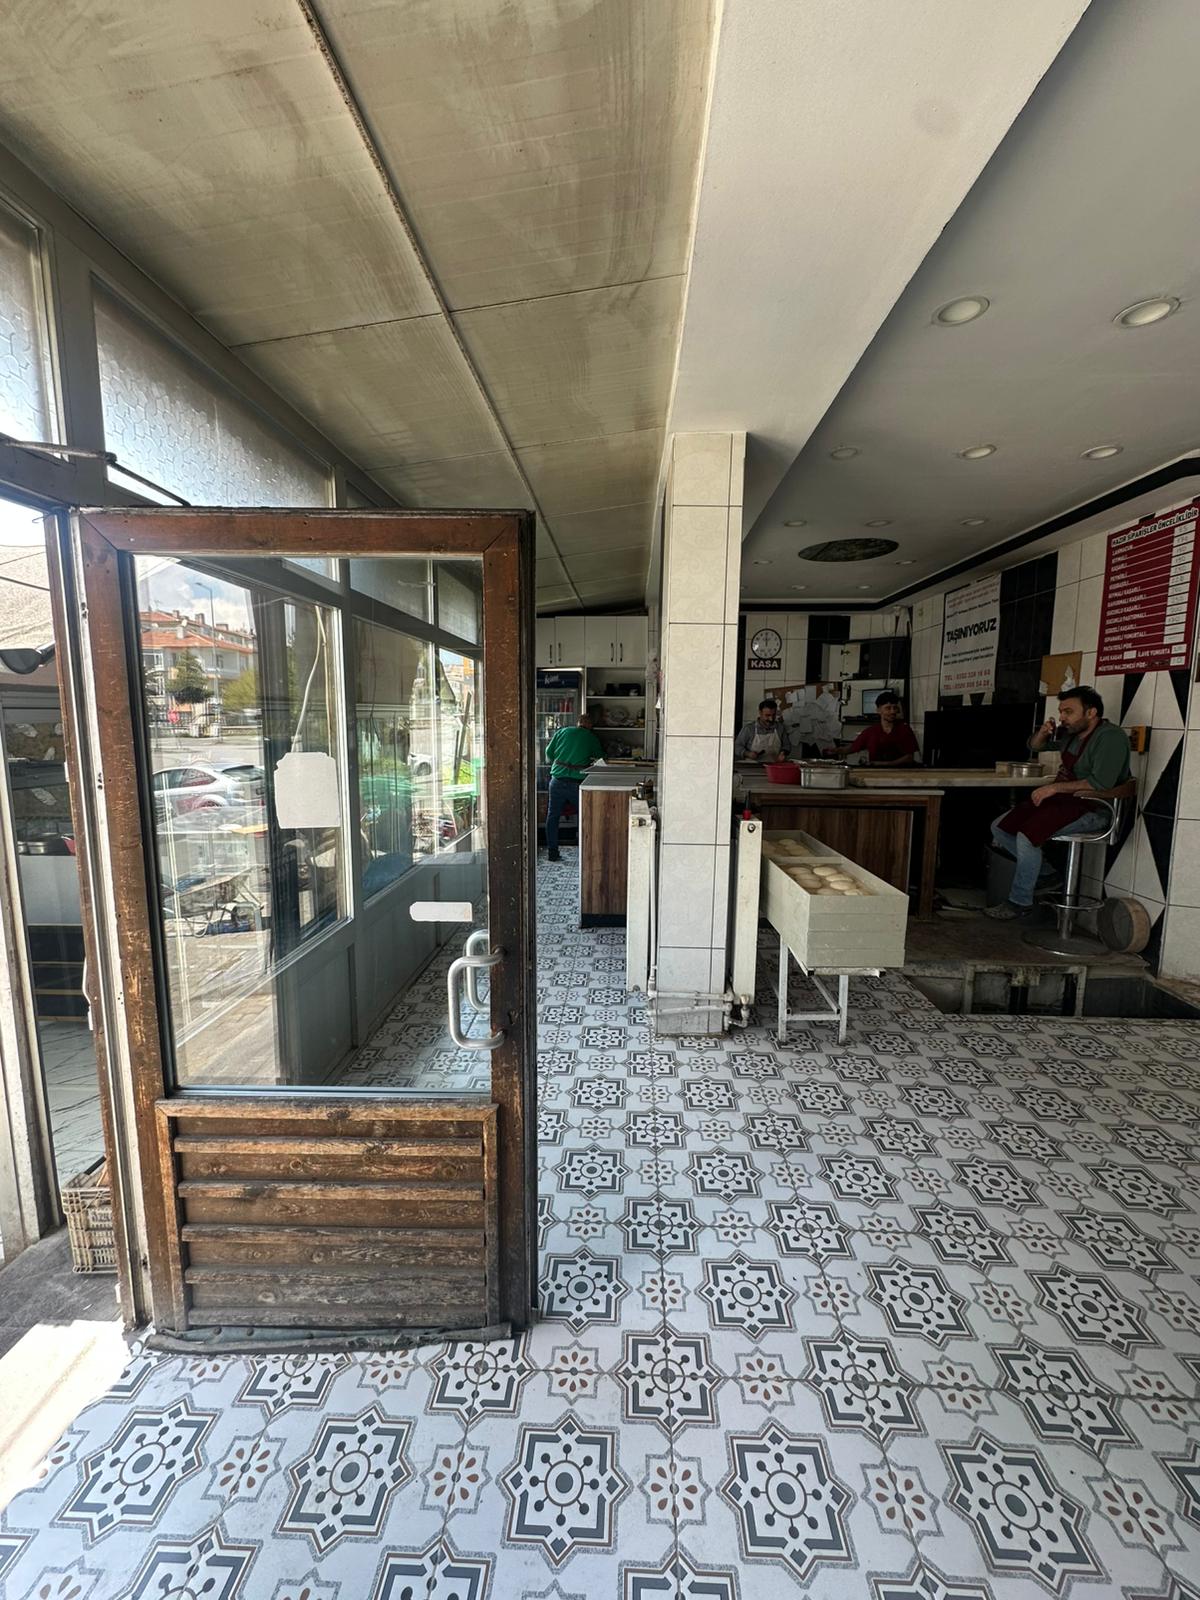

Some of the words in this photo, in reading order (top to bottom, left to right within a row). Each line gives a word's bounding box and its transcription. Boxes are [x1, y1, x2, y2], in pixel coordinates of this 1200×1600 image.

[1112, 536, 1126, 546] HAZIR
[1128, 525, 1157, 542] SİPARİŞLER
[1158, 508, 1198, 530] ÖNCELİKLİDİR
[946, 618, 996, 644] TAŞINIYORUZ
[751, 660, 779, 668] KASA
